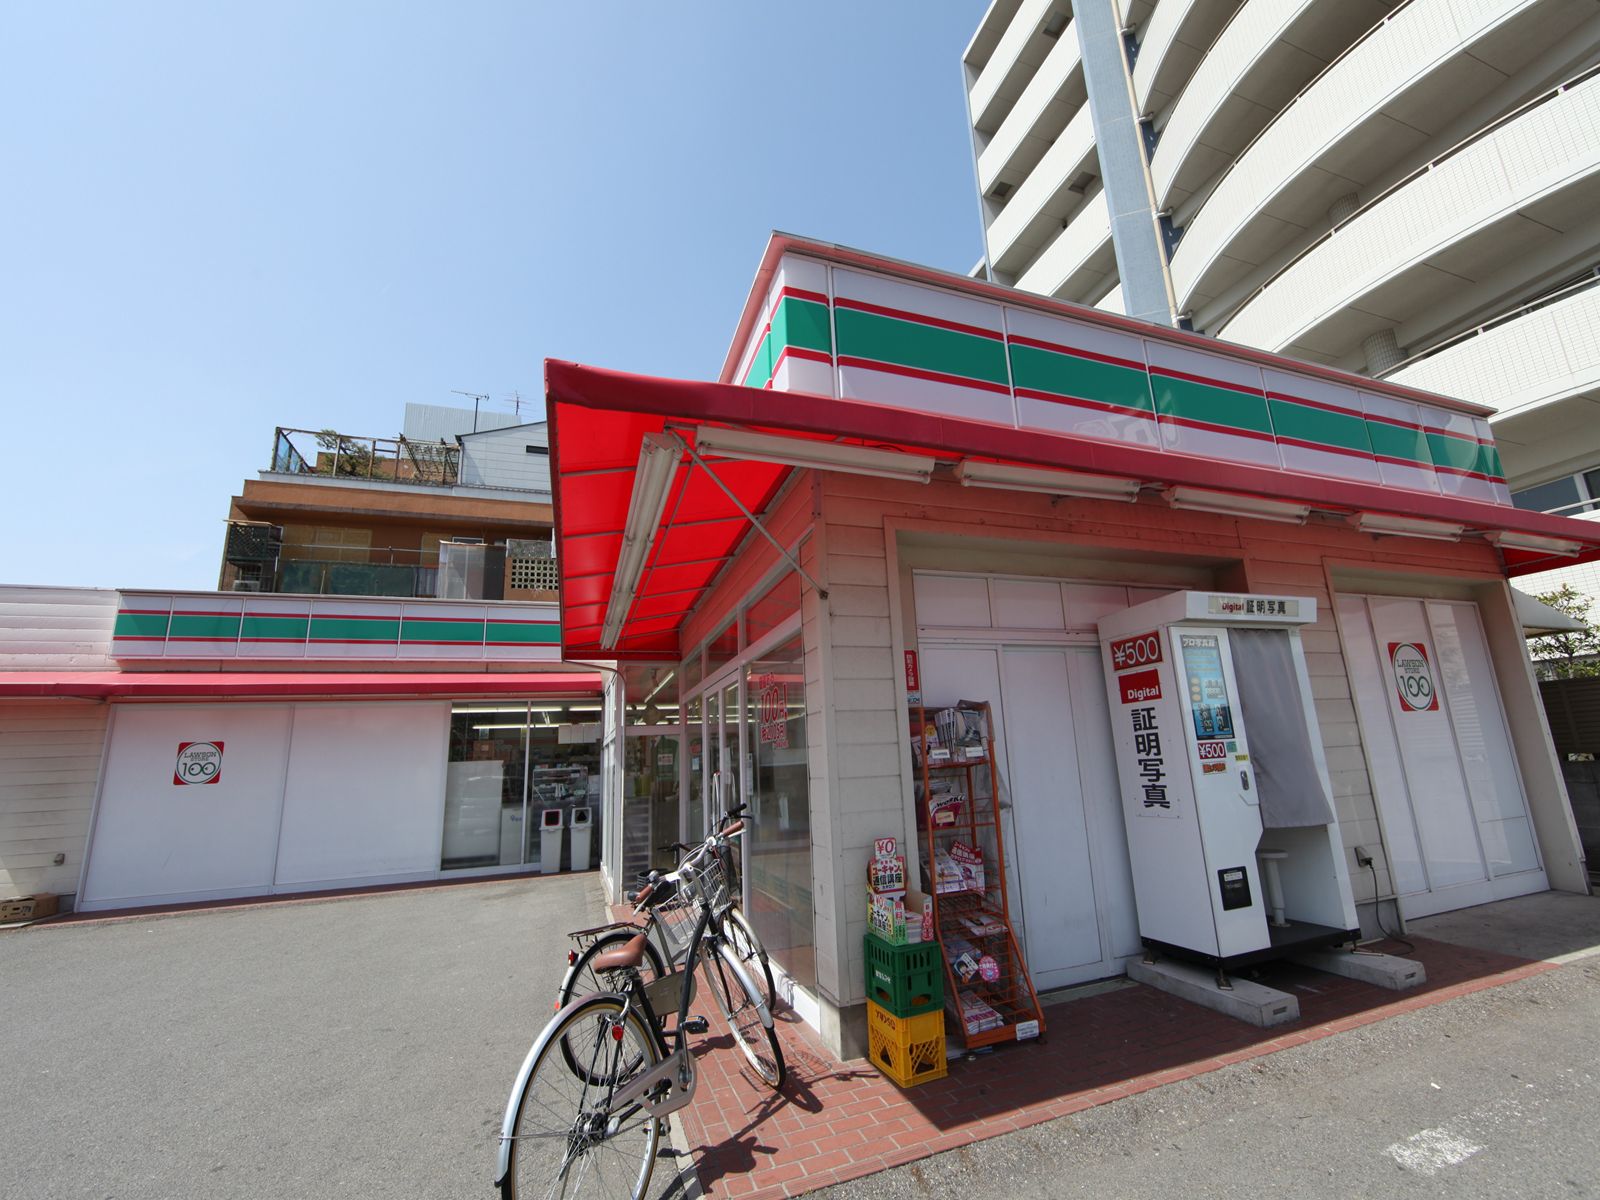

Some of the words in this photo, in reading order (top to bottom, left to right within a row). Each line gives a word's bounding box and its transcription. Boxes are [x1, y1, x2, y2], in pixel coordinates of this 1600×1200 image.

[1222, 599, 1244, 613] Digital
[1246, 599, 1287, 615] 証明写真
[1113, 636, 1159, 665] ¥500
[1396, 659, 1425, 668] LAWSON
[1127, 684, 1160, 701] Digital
[1399, 675, 1431, 698] 100
[1130, 706, 1171, 810] 証明写真
[1198, 742, 1226, 759] ¥500
[182, 762, 216, 777] 100
[876, 839, 895, 855] ¥0
[873, 873, 903, 886] 通信講座
